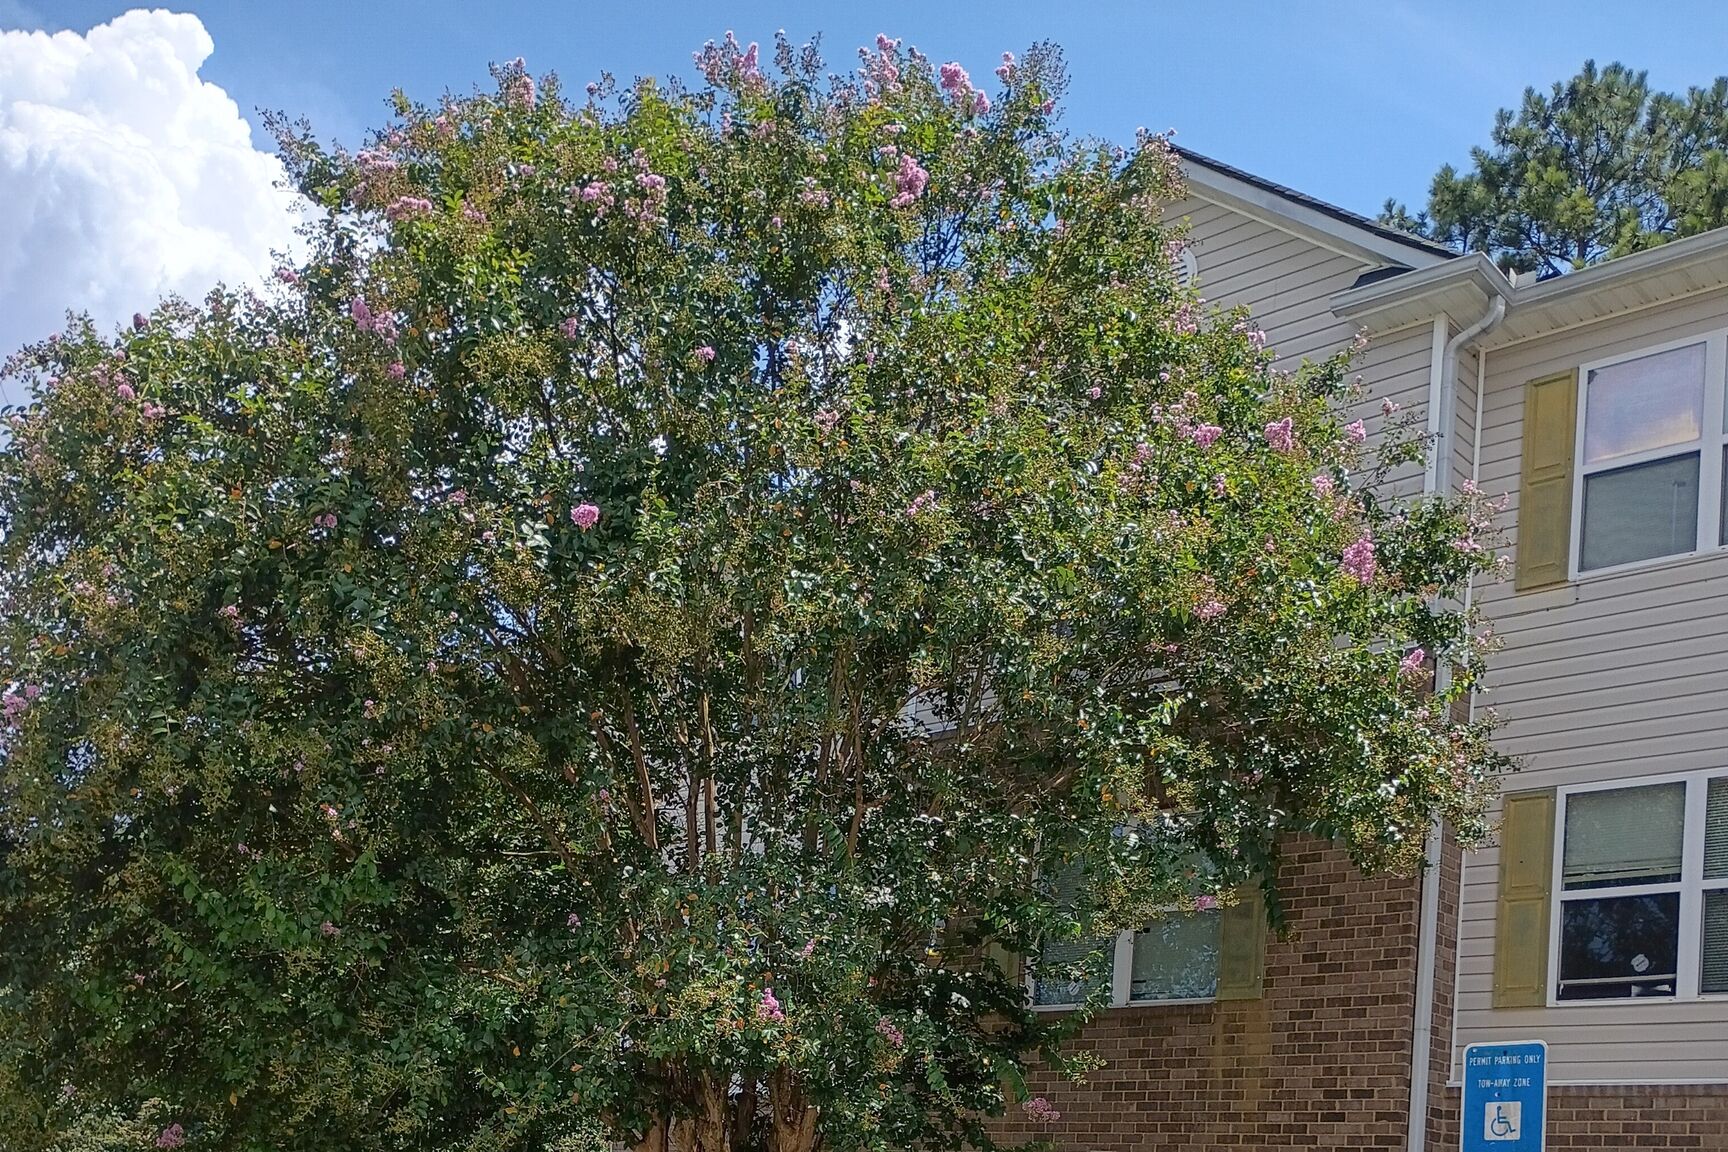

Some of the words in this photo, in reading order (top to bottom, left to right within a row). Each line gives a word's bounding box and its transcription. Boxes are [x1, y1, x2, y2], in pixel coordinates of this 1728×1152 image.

[1469, 1056, 1491, 1066] PERMIT
[1494, 1055, 1521, 1065] PARKING
[1524, 1054, 1541, 1064] ONLY
[1478, 1079, 1511, 1089] TOW-AWAY
[1513, 1077, 1531, 1087] ZONE
